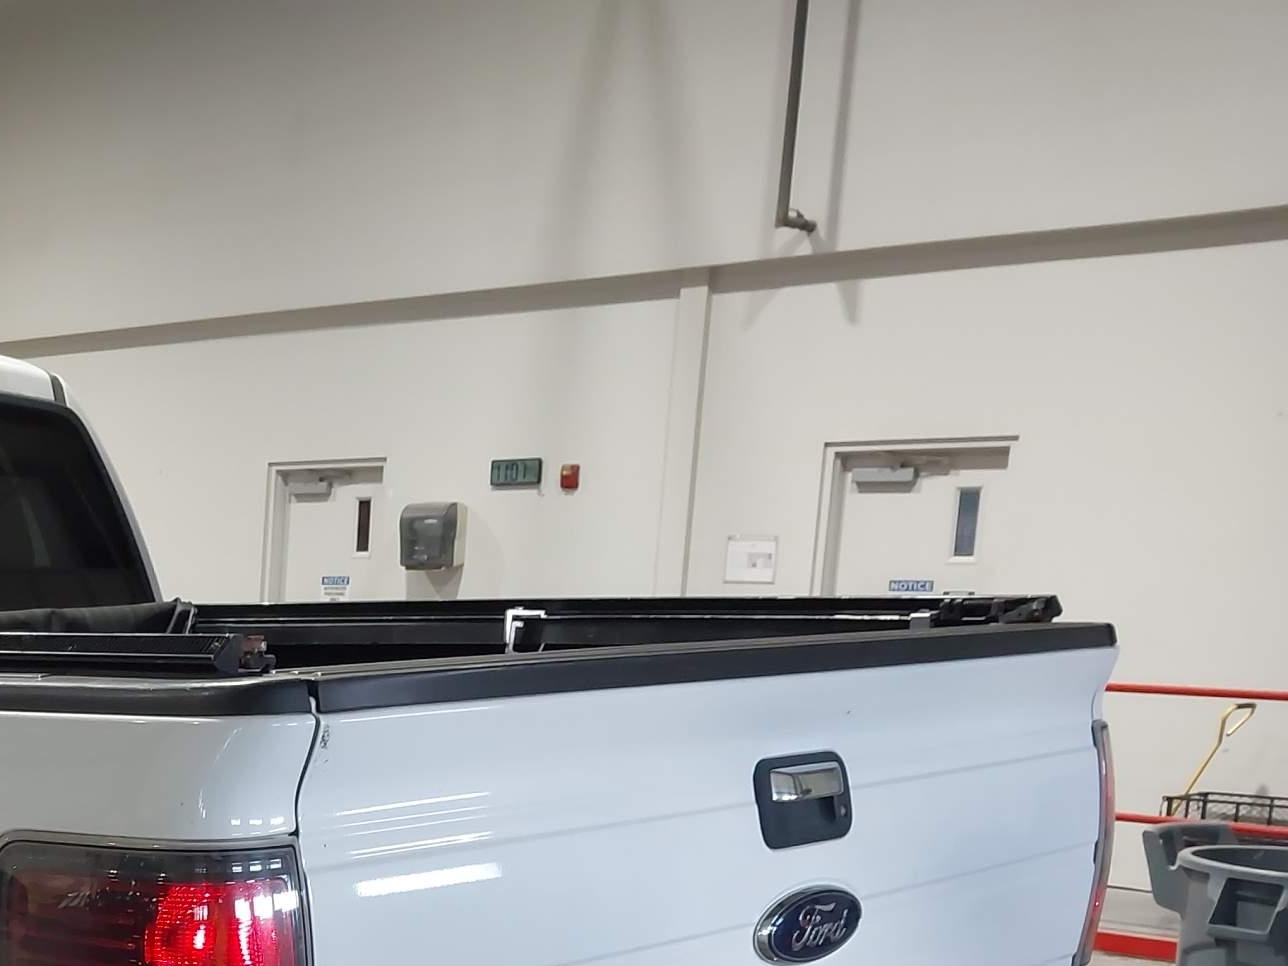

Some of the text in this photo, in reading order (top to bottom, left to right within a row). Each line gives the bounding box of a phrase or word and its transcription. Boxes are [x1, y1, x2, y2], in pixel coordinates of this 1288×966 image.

[323, 576, 349, 585] NOTICE
[890, 581, 933, 592] NOTICE
[791, 902, 849, 952] Ford
